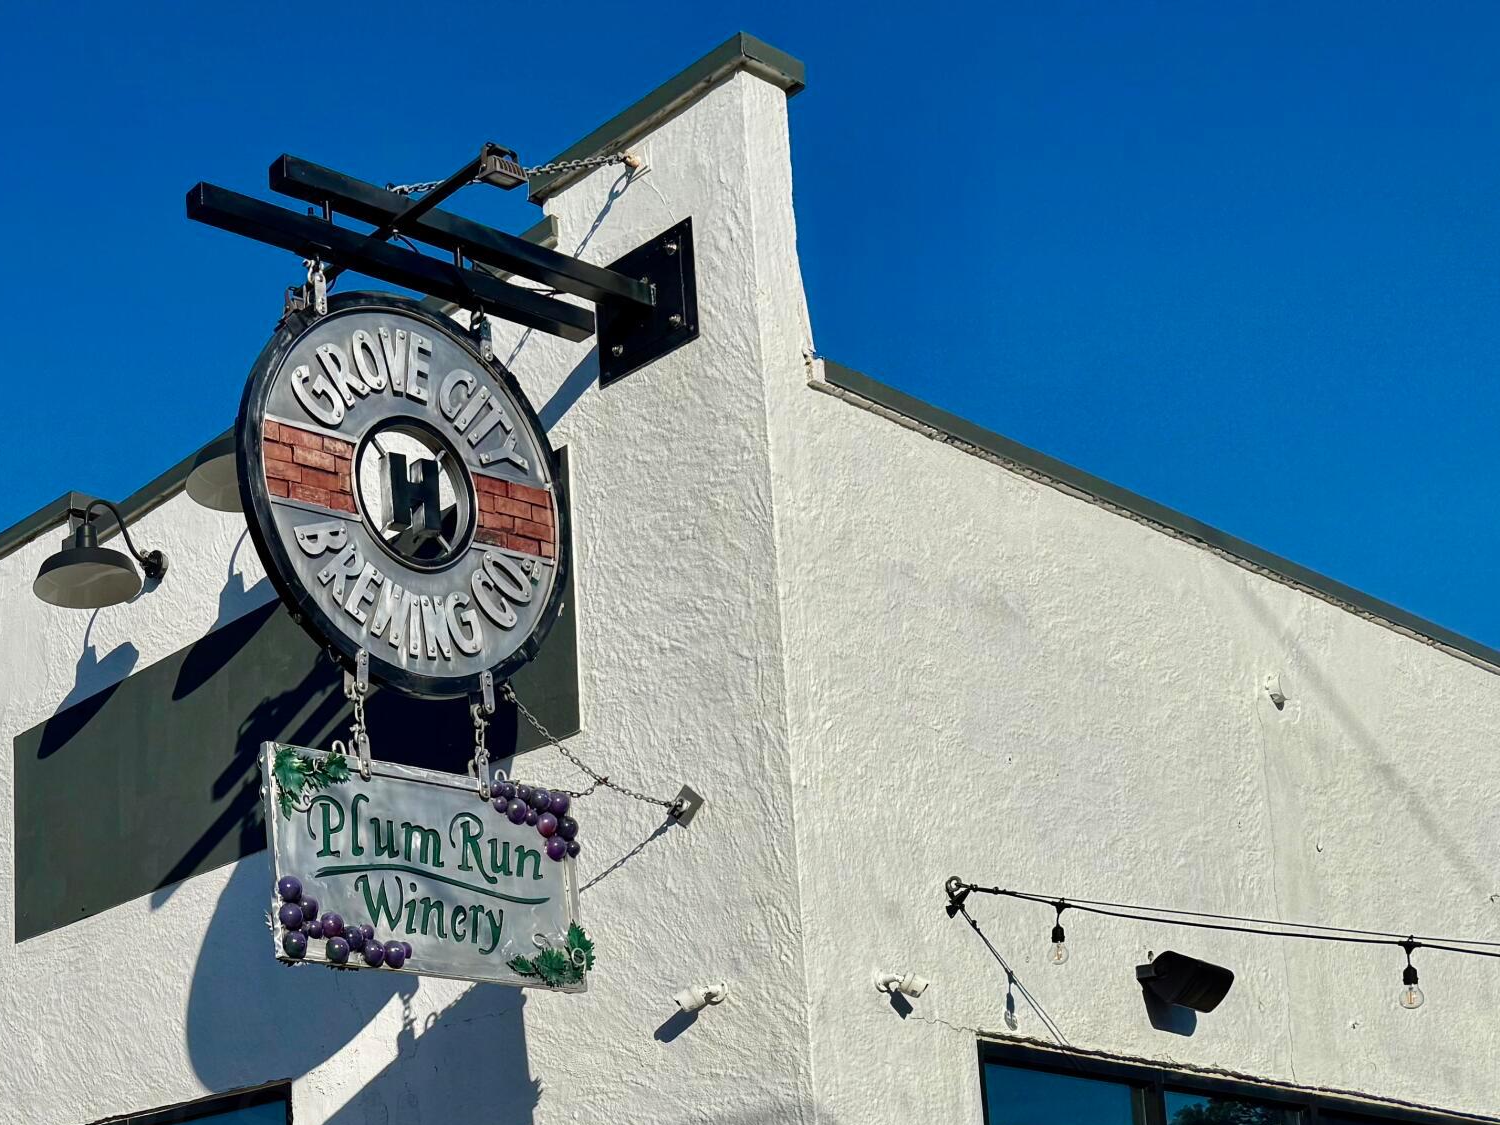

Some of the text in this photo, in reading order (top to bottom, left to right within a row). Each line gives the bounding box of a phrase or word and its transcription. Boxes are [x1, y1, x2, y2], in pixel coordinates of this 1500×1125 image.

[293, 327, 529, 472] GROVE CITY
[380, 451, 441, 540] H
[294, 522, 483, 660] BREWING
[307, 794, 543, 881] Plum Run
[355, 872, 505, 955] Winery
